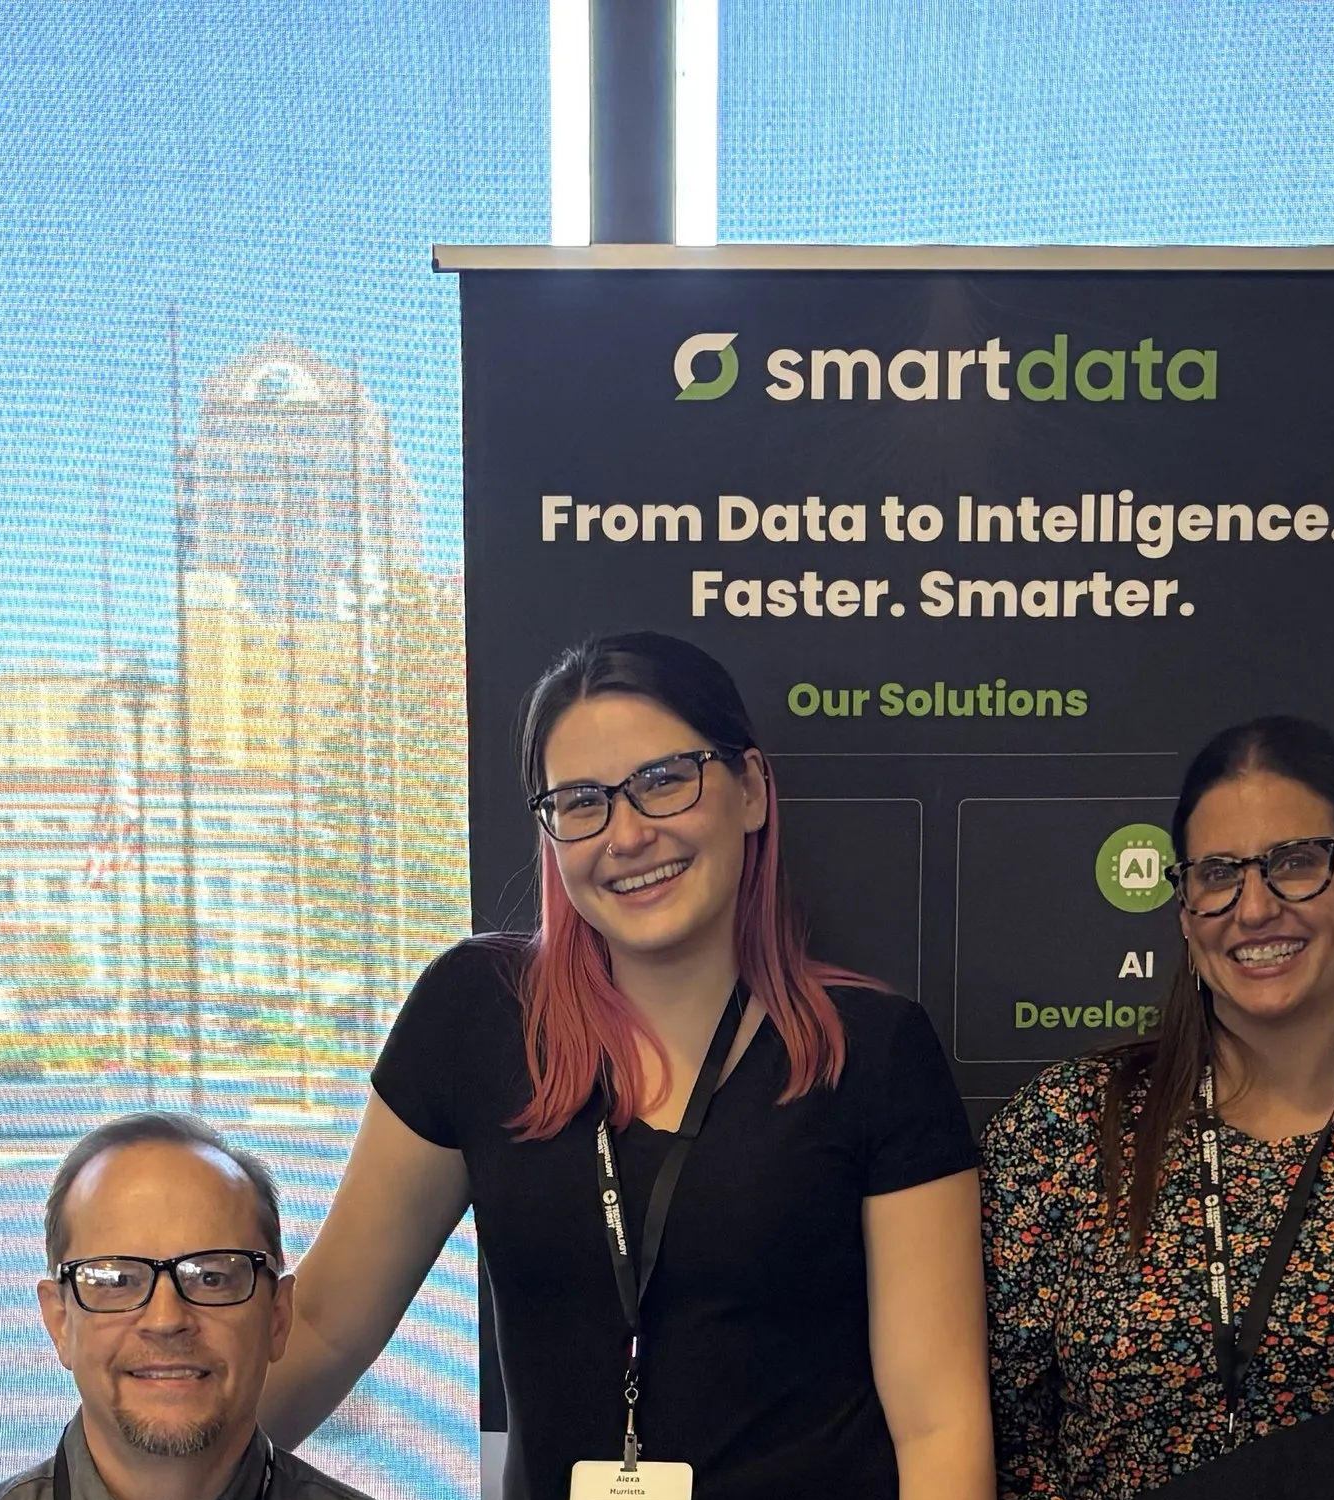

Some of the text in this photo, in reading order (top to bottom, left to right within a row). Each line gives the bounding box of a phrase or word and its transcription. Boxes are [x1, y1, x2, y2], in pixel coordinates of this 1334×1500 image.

[765, 335, 1217, 401] smartdata
[540, 495, 703, 543] From
[717, 496, 867, 543] Data
[882, 496, 943, 543] to
[690, 570, 1195, 619] Faster. Smarter.
[788, 679, 1088, 718] Our Solutions
[1118, 951, 1154, 978] AI
[605, 1205, 615, 1229] FIRST
[612, 1203, 627, 1256] TECHNOLOGY
[1210, 1275, 1218, 1298] FIRST
[1219, 1275, 1230, 1325] TECHNOLOGY
